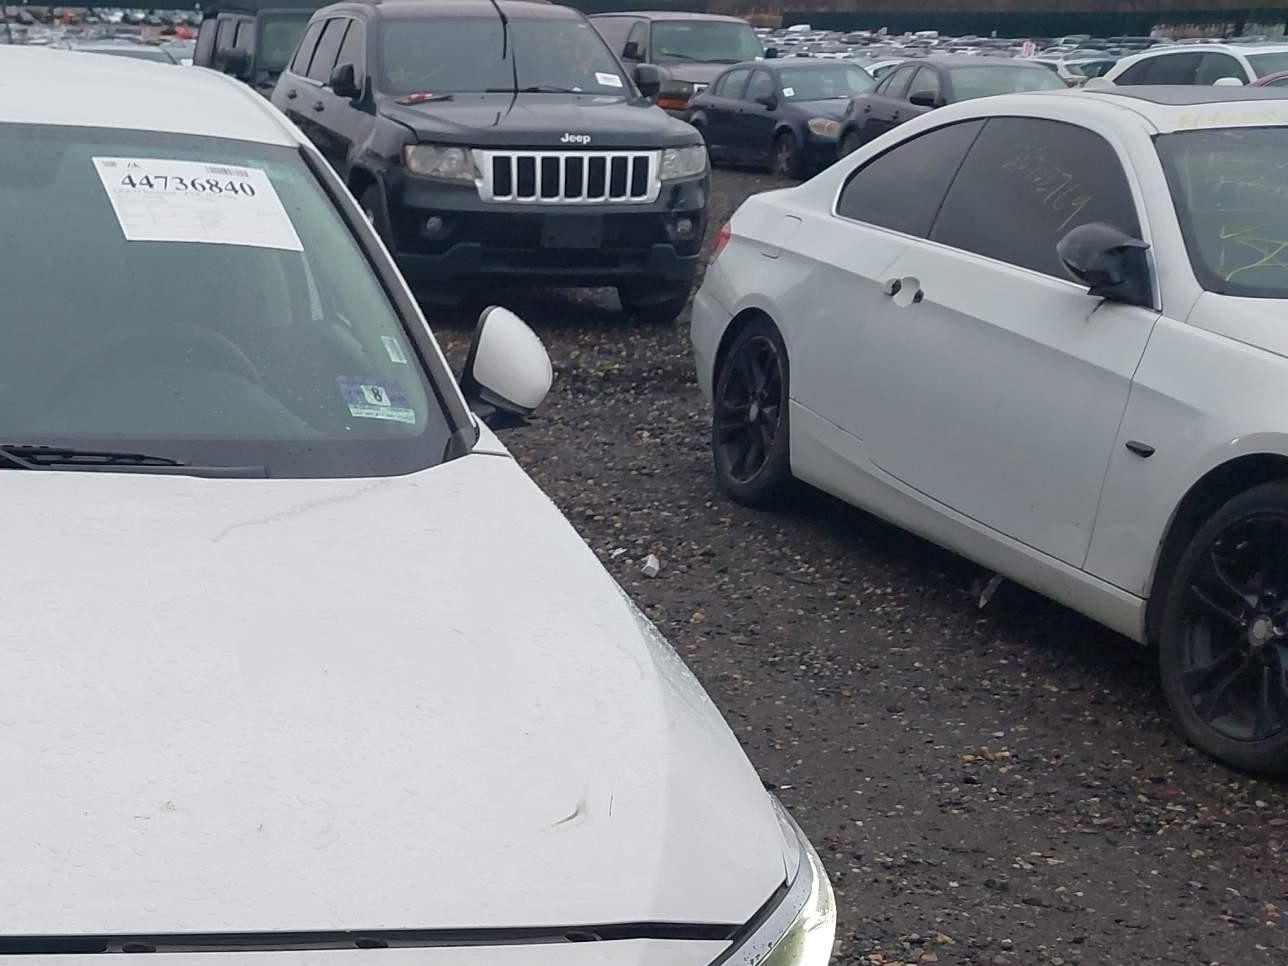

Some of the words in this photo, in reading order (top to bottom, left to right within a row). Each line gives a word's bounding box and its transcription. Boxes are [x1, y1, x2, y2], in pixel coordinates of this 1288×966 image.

[560, 132, 591, 145] Jeep
[121, 174, 256, 197] 44736840
[371, 387, 383, 402] 8
